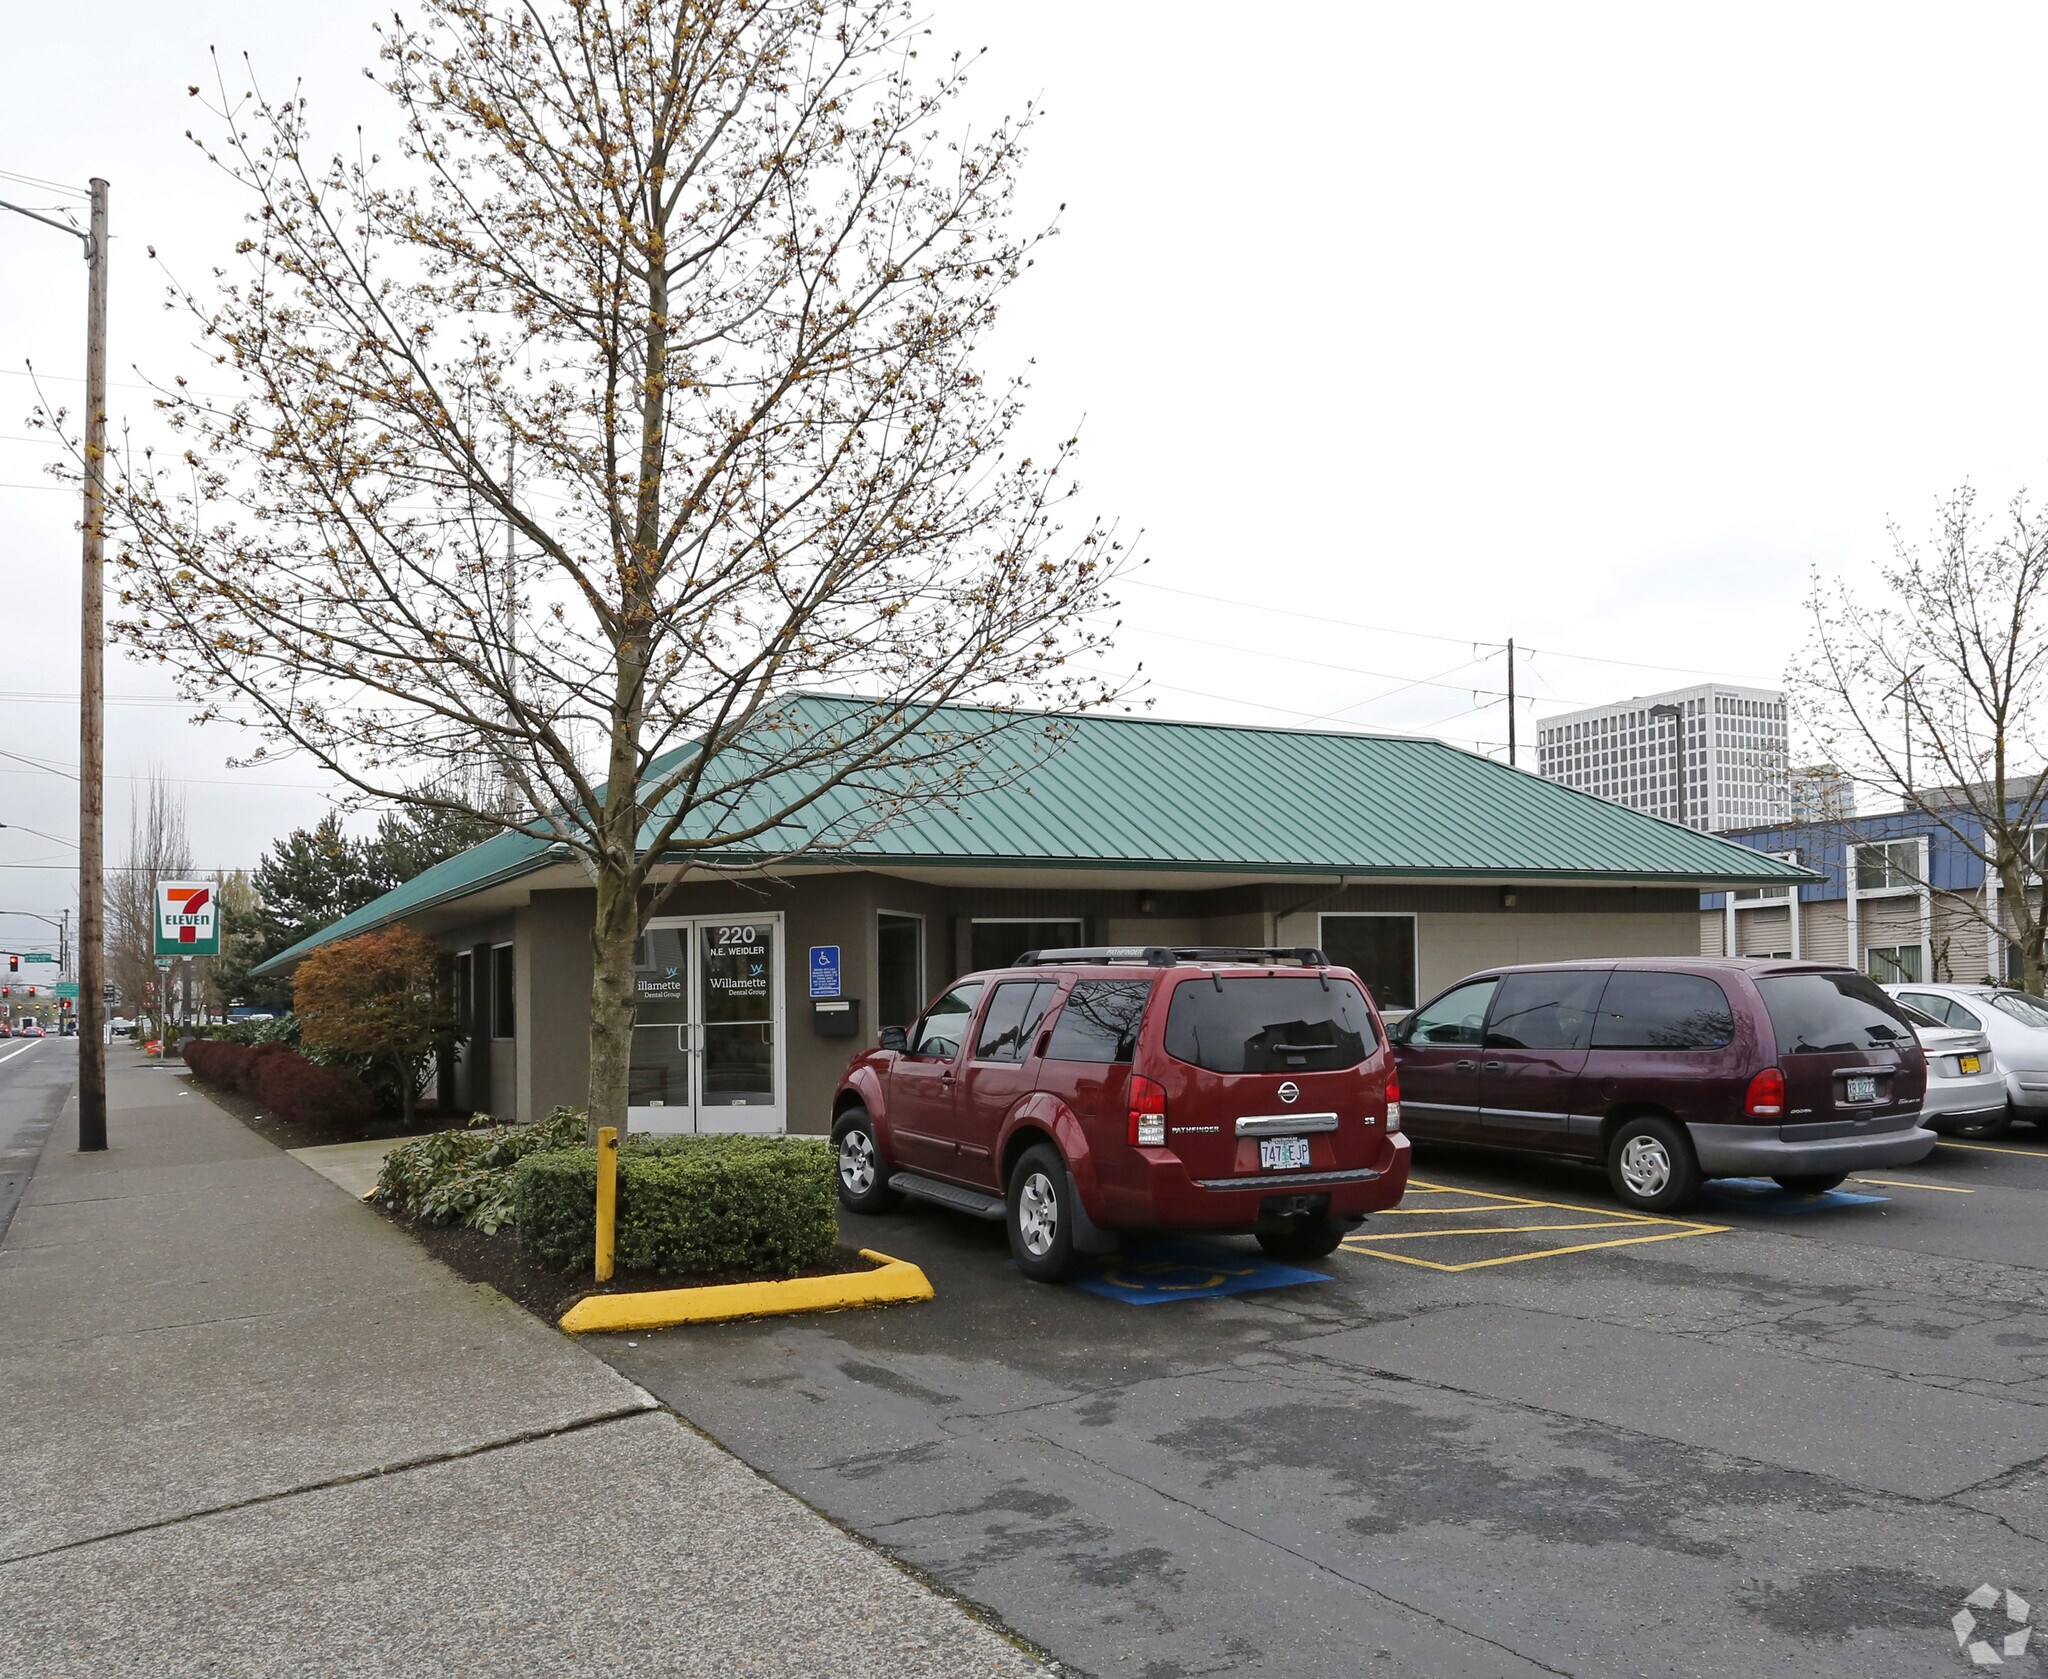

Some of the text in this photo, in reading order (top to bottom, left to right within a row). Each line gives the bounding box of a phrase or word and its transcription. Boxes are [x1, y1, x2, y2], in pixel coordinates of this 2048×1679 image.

[167, 888, 209, 943] 7
[718, 926, 756, 945] 220
[710, 946, 765, 956] N.E. WEIDLER
[638, 980, 681, 991] illamette
[710, 978, 766, 988] Willamette
[644, 991, 680, 999] Dental Group
[728, 988, 766, 996] Dental Group
[1171, 1125, 1220, 1134] PATHFINDER
[1262, 1144, 1308, 1162] 747 EJP
